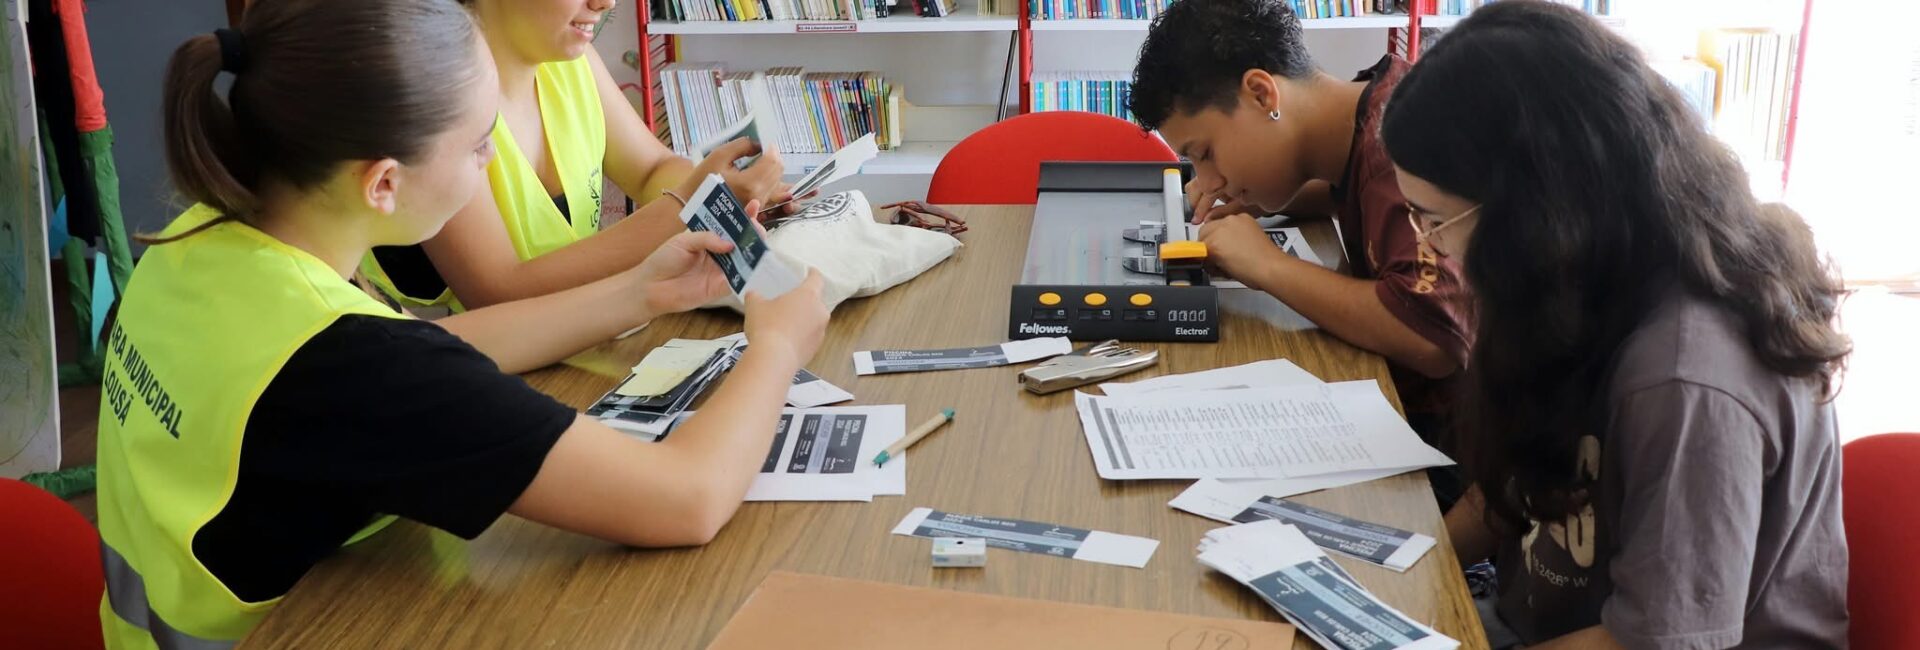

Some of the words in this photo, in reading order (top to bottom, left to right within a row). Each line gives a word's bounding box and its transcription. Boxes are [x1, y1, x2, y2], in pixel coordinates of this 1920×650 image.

[718, 191, 734, 212] PISCINA
[1019, 322, 1069, 334] Fellowes
[1175, 327, 1208, 336] Electron
[104, 362, 135, 427] LOUSÃ
[124, 344, 183, 440] MUNICIPAL
[1572, 576, 1589, 587] W
